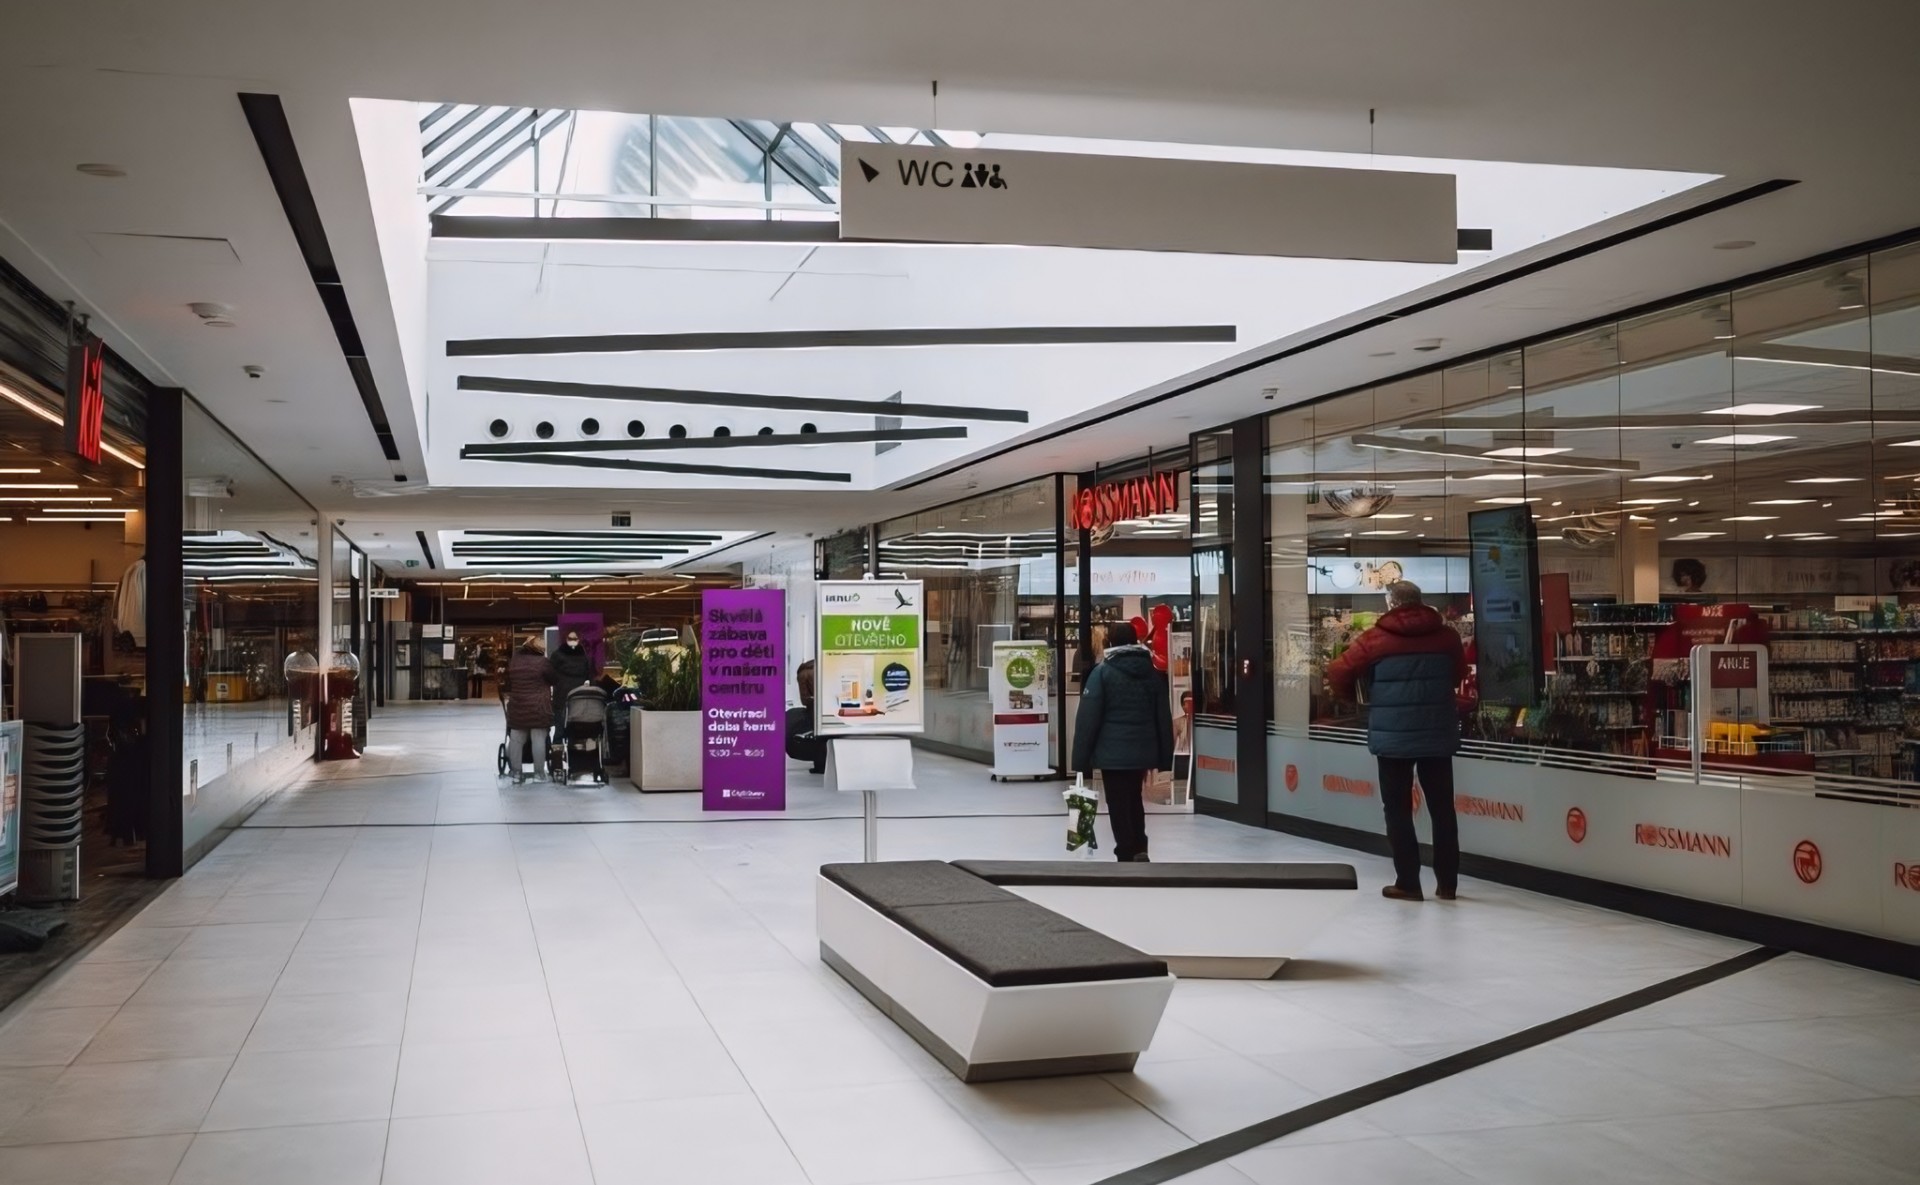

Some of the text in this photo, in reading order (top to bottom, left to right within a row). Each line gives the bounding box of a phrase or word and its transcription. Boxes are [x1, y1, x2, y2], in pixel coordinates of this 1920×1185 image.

[898, 159, 954, 187] WC
[1071, 470, 1178, 530] ROSSMANN
[708, 626, 767, 641] zábava
[834, 632, 907, 648] OTEVŘENO
[708, 644, 775, 662] pro děti
[708, 662, 777, 677] v našem
[708, 680, 765, 695] centru
[708, 720, 740, 732] doba
[708, 734, 738, 748] zóny
[1634, 823, 1731, 858] ROSSMANN
